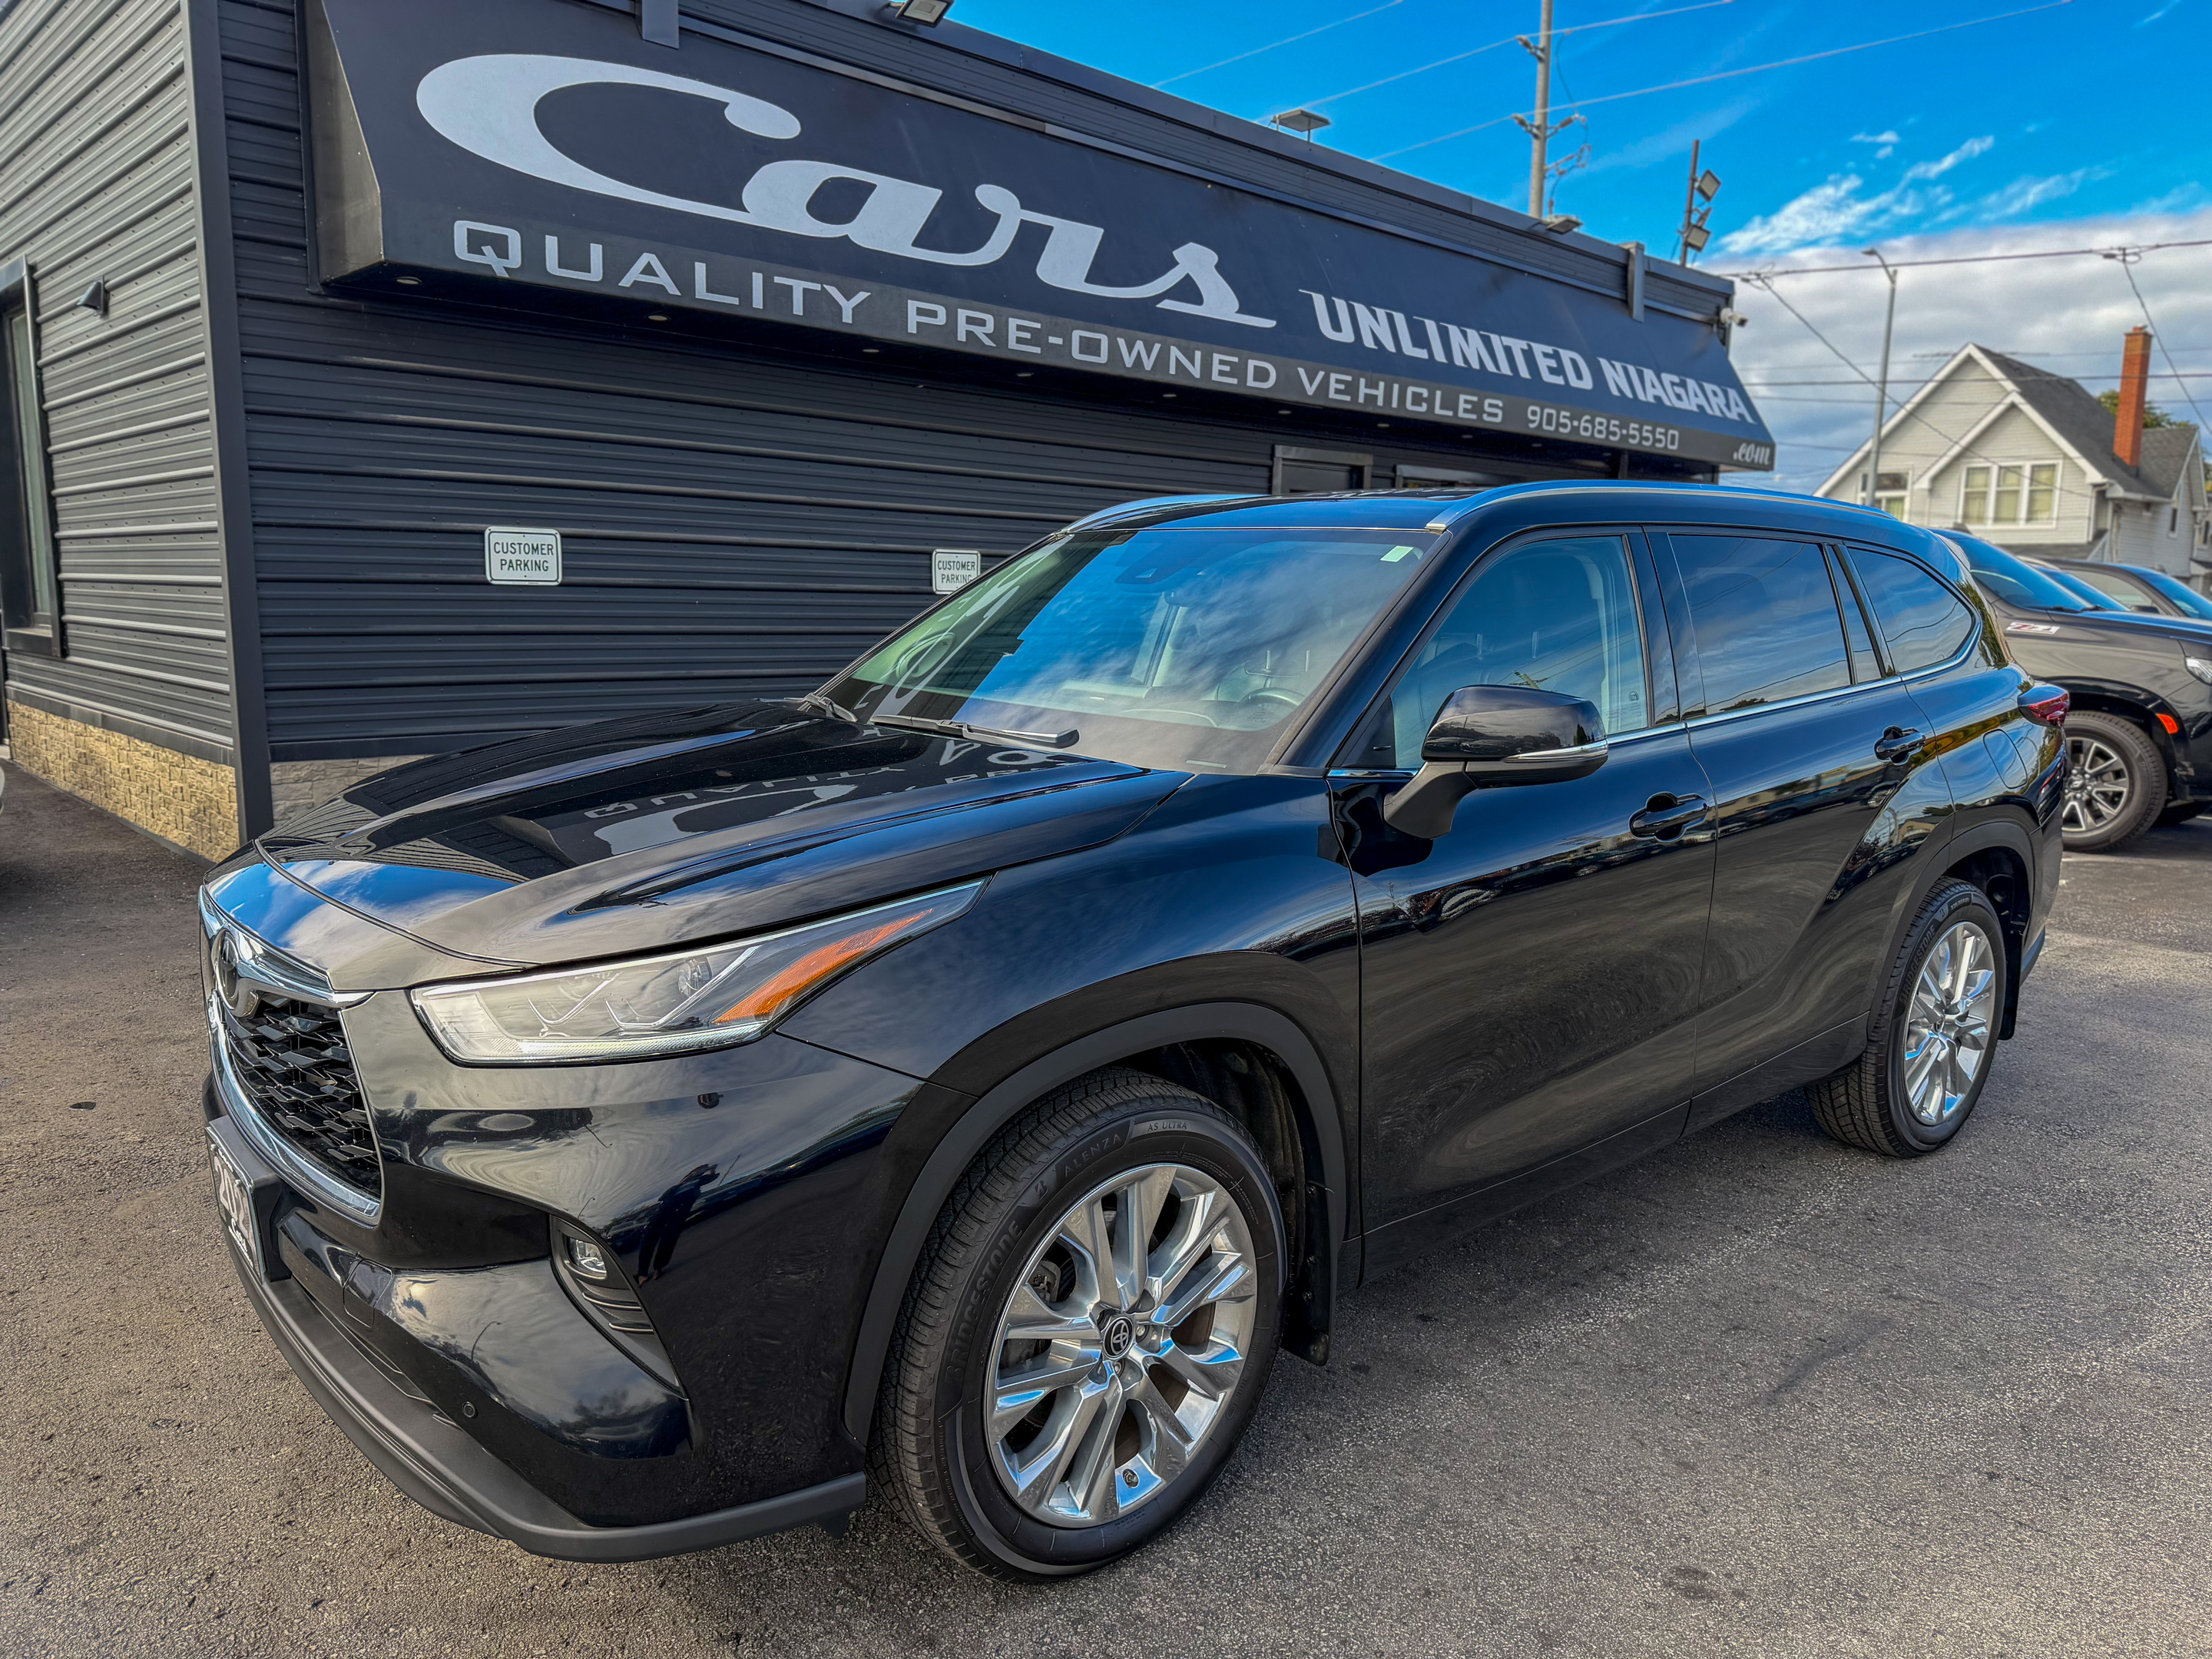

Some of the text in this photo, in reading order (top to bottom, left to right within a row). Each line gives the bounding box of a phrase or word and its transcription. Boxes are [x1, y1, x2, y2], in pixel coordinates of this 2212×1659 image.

[416, 54, 1757, 425] Cars UNLIMITED NIAGARA
[453, 220, 1680, 450] QUALITY PRE-OWNED VEHICLES 905-685-5550
[1733, 442, 1771, 465] .com
[493, 541, 555, 556] CUSTOMER
[500, 558, 549, 572] PARKING
[938, 560, 975, 571] CUSTOMER
[1065, 1121, 1188, 1177] ALENZA AS ULTRA
[944, 1219, 1023, 1382] BRIDGESTONE
